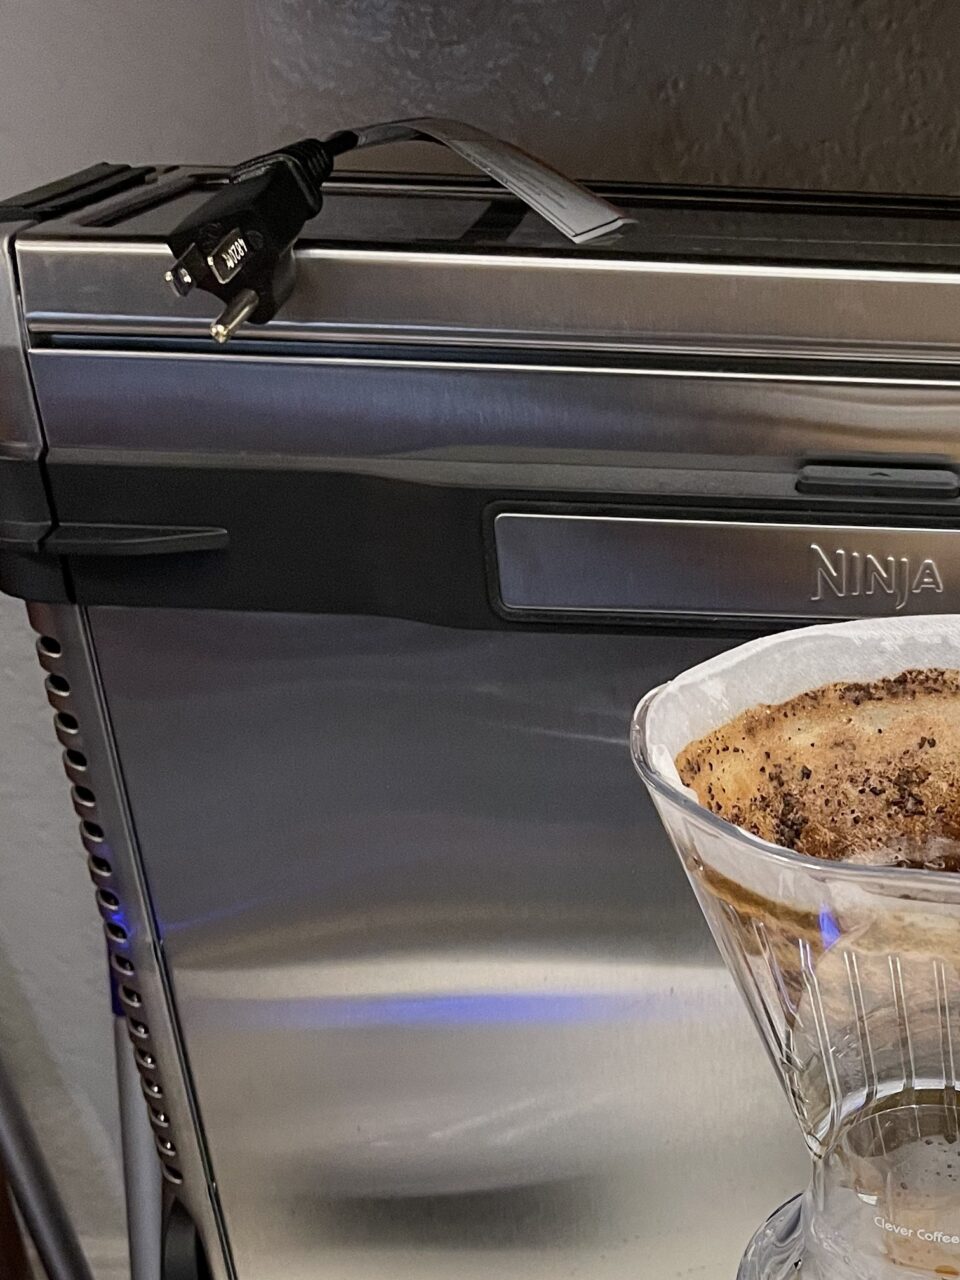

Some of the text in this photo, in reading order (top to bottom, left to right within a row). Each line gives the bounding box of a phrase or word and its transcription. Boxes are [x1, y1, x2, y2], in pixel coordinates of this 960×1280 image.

[810, 544, 944, 610] NINJA
[874, 1216, 914, 1238] Clever
[917, 1228, 960, 1245] Coffee
